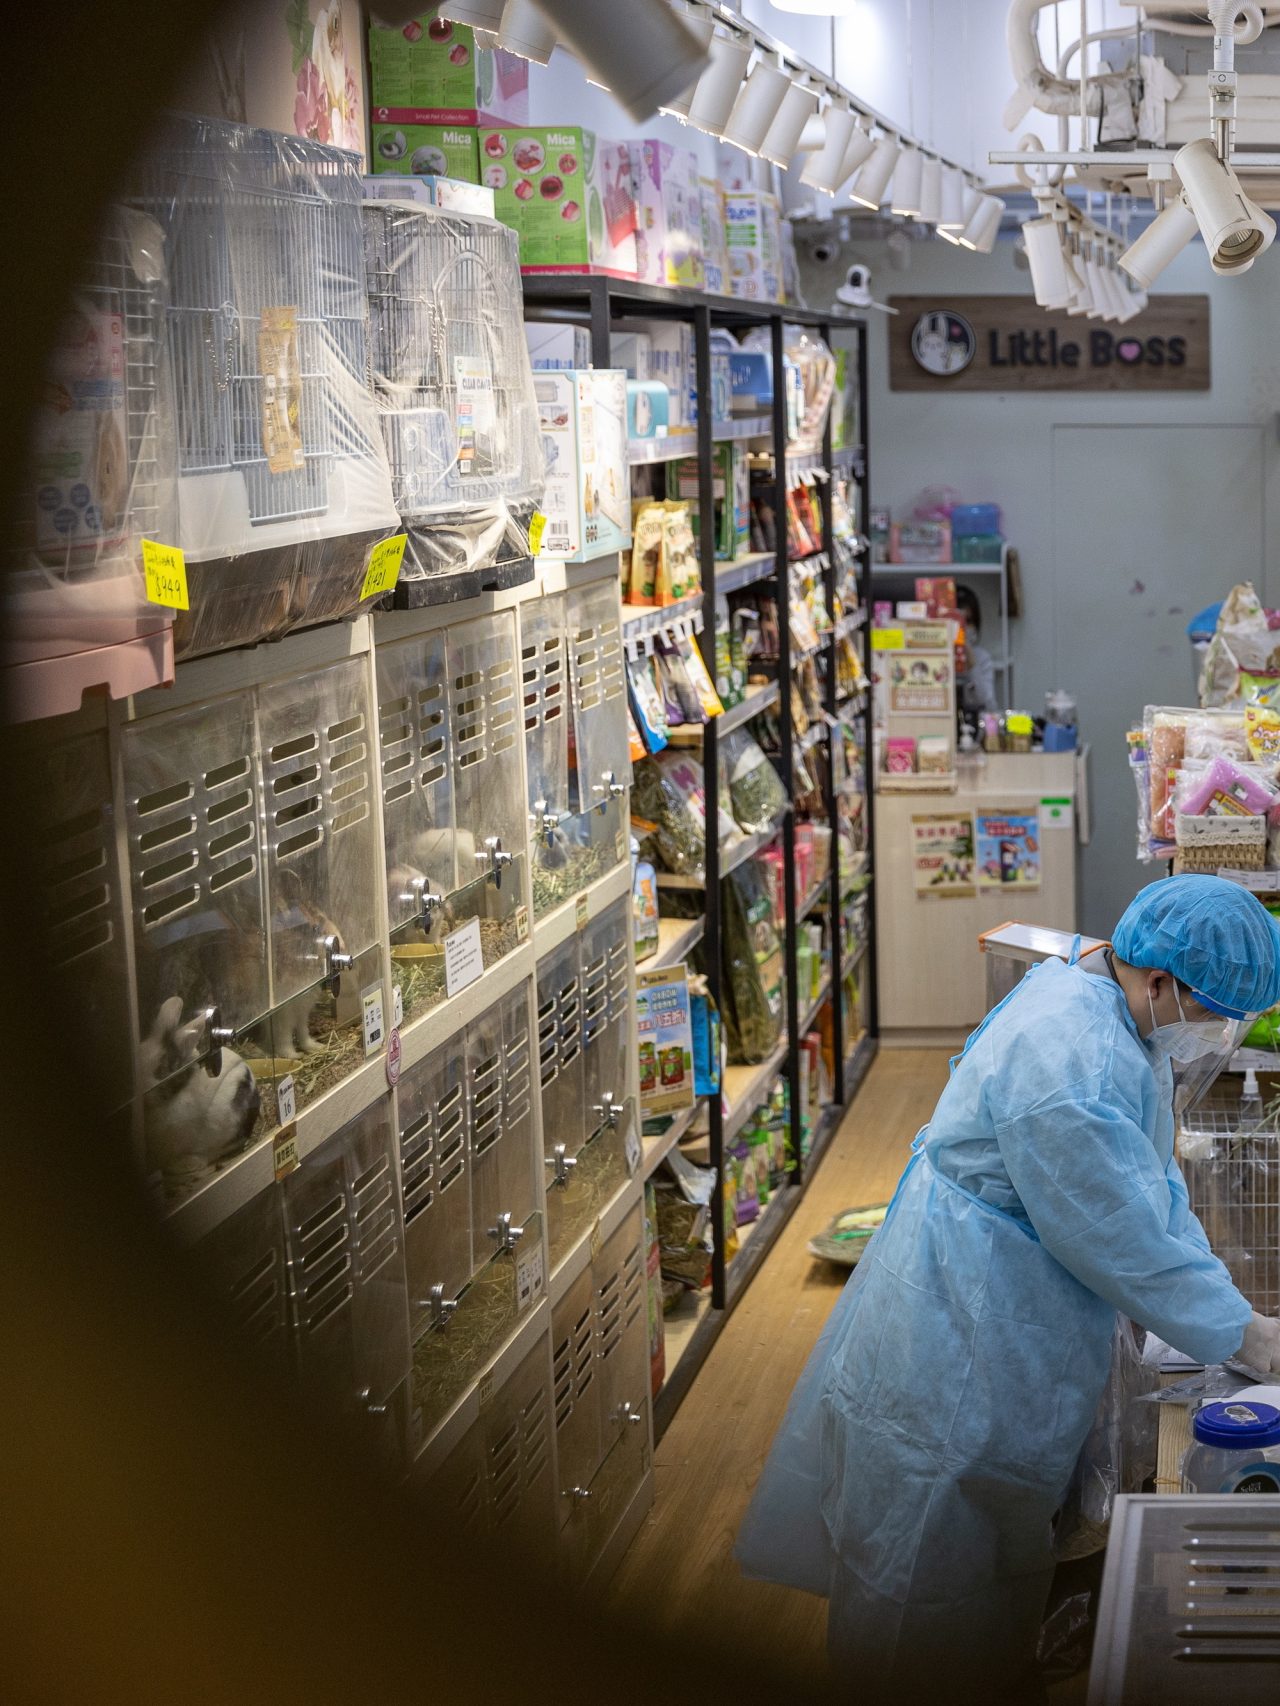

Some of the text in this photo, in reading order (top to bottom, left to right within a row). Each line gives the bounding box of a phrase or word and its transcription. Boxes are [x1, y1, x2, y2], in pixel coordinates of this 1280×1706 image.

[443, 131, 472, 144] Mica
[547, 133, 576, 145] Mica
[989, 328, 1187, 367] Little Boss
[283, 1099, 292, 1117] 16
